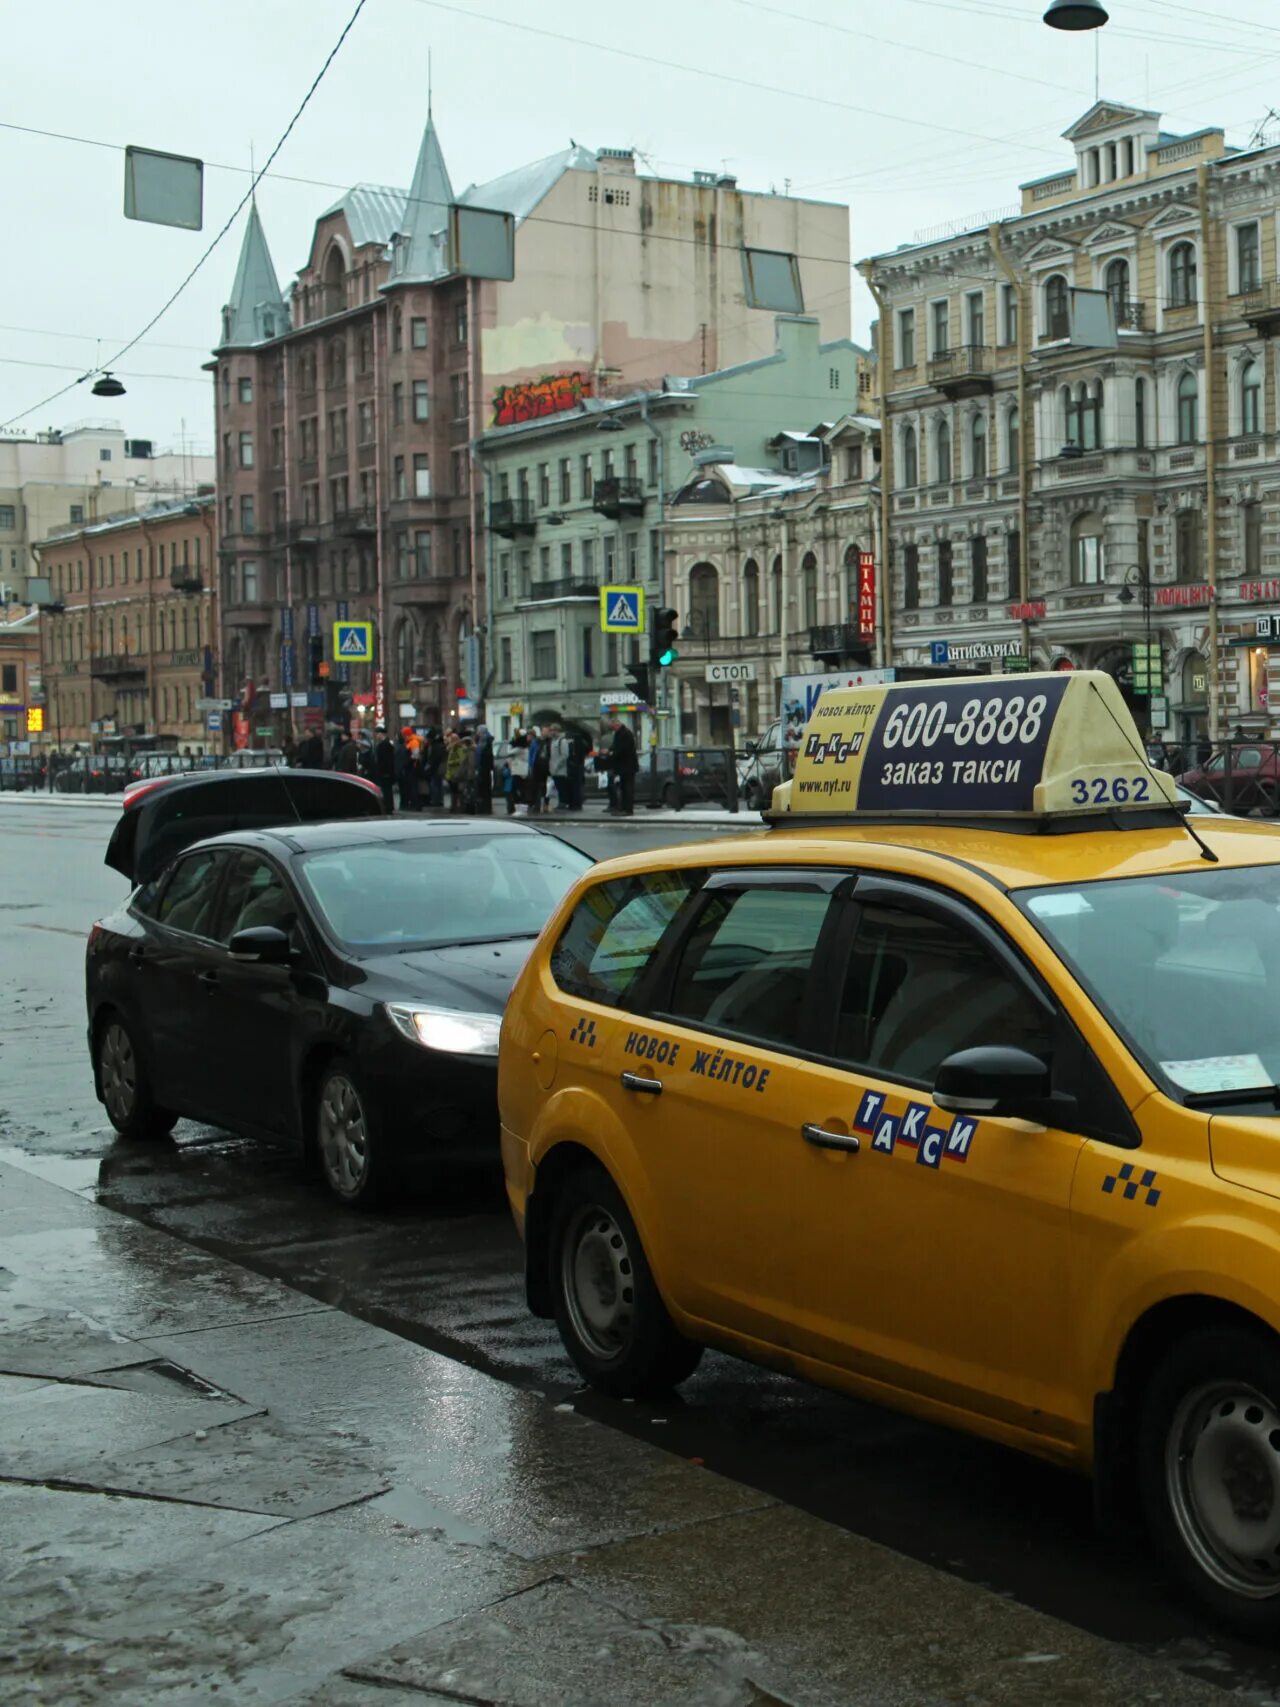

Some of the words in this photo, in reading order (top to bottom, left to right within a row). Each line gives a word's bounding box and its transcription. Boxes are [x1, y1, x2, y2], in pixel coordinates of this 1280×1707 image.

[860, 554, 874, 633] ШТАМПЫ
[711, 665, 749, 680] СТОП
[600, 691, 646, 704] СВЯЗНО
[817, 705, 844, 718] НОВОЕ
[846, 703, 877, 716] ЖЁЛТОЕ
[883, 694, 1047, 749] 600-8888
[808, 732, 864, 763] ТАКСИ
[881, 761, 944, 785] заказ
[952, 759, 1022, 784] такси
[799, 779, 851, 796] www.nyt.ru
[1071, 777, 1150, 804] 3262
[624, 1031, 681, 1067] НОВОЕ
[690, 1048, 771, 1092] ЖЁЛТОЕ
[863, 1095, 973, 1164] ТАКСИ
